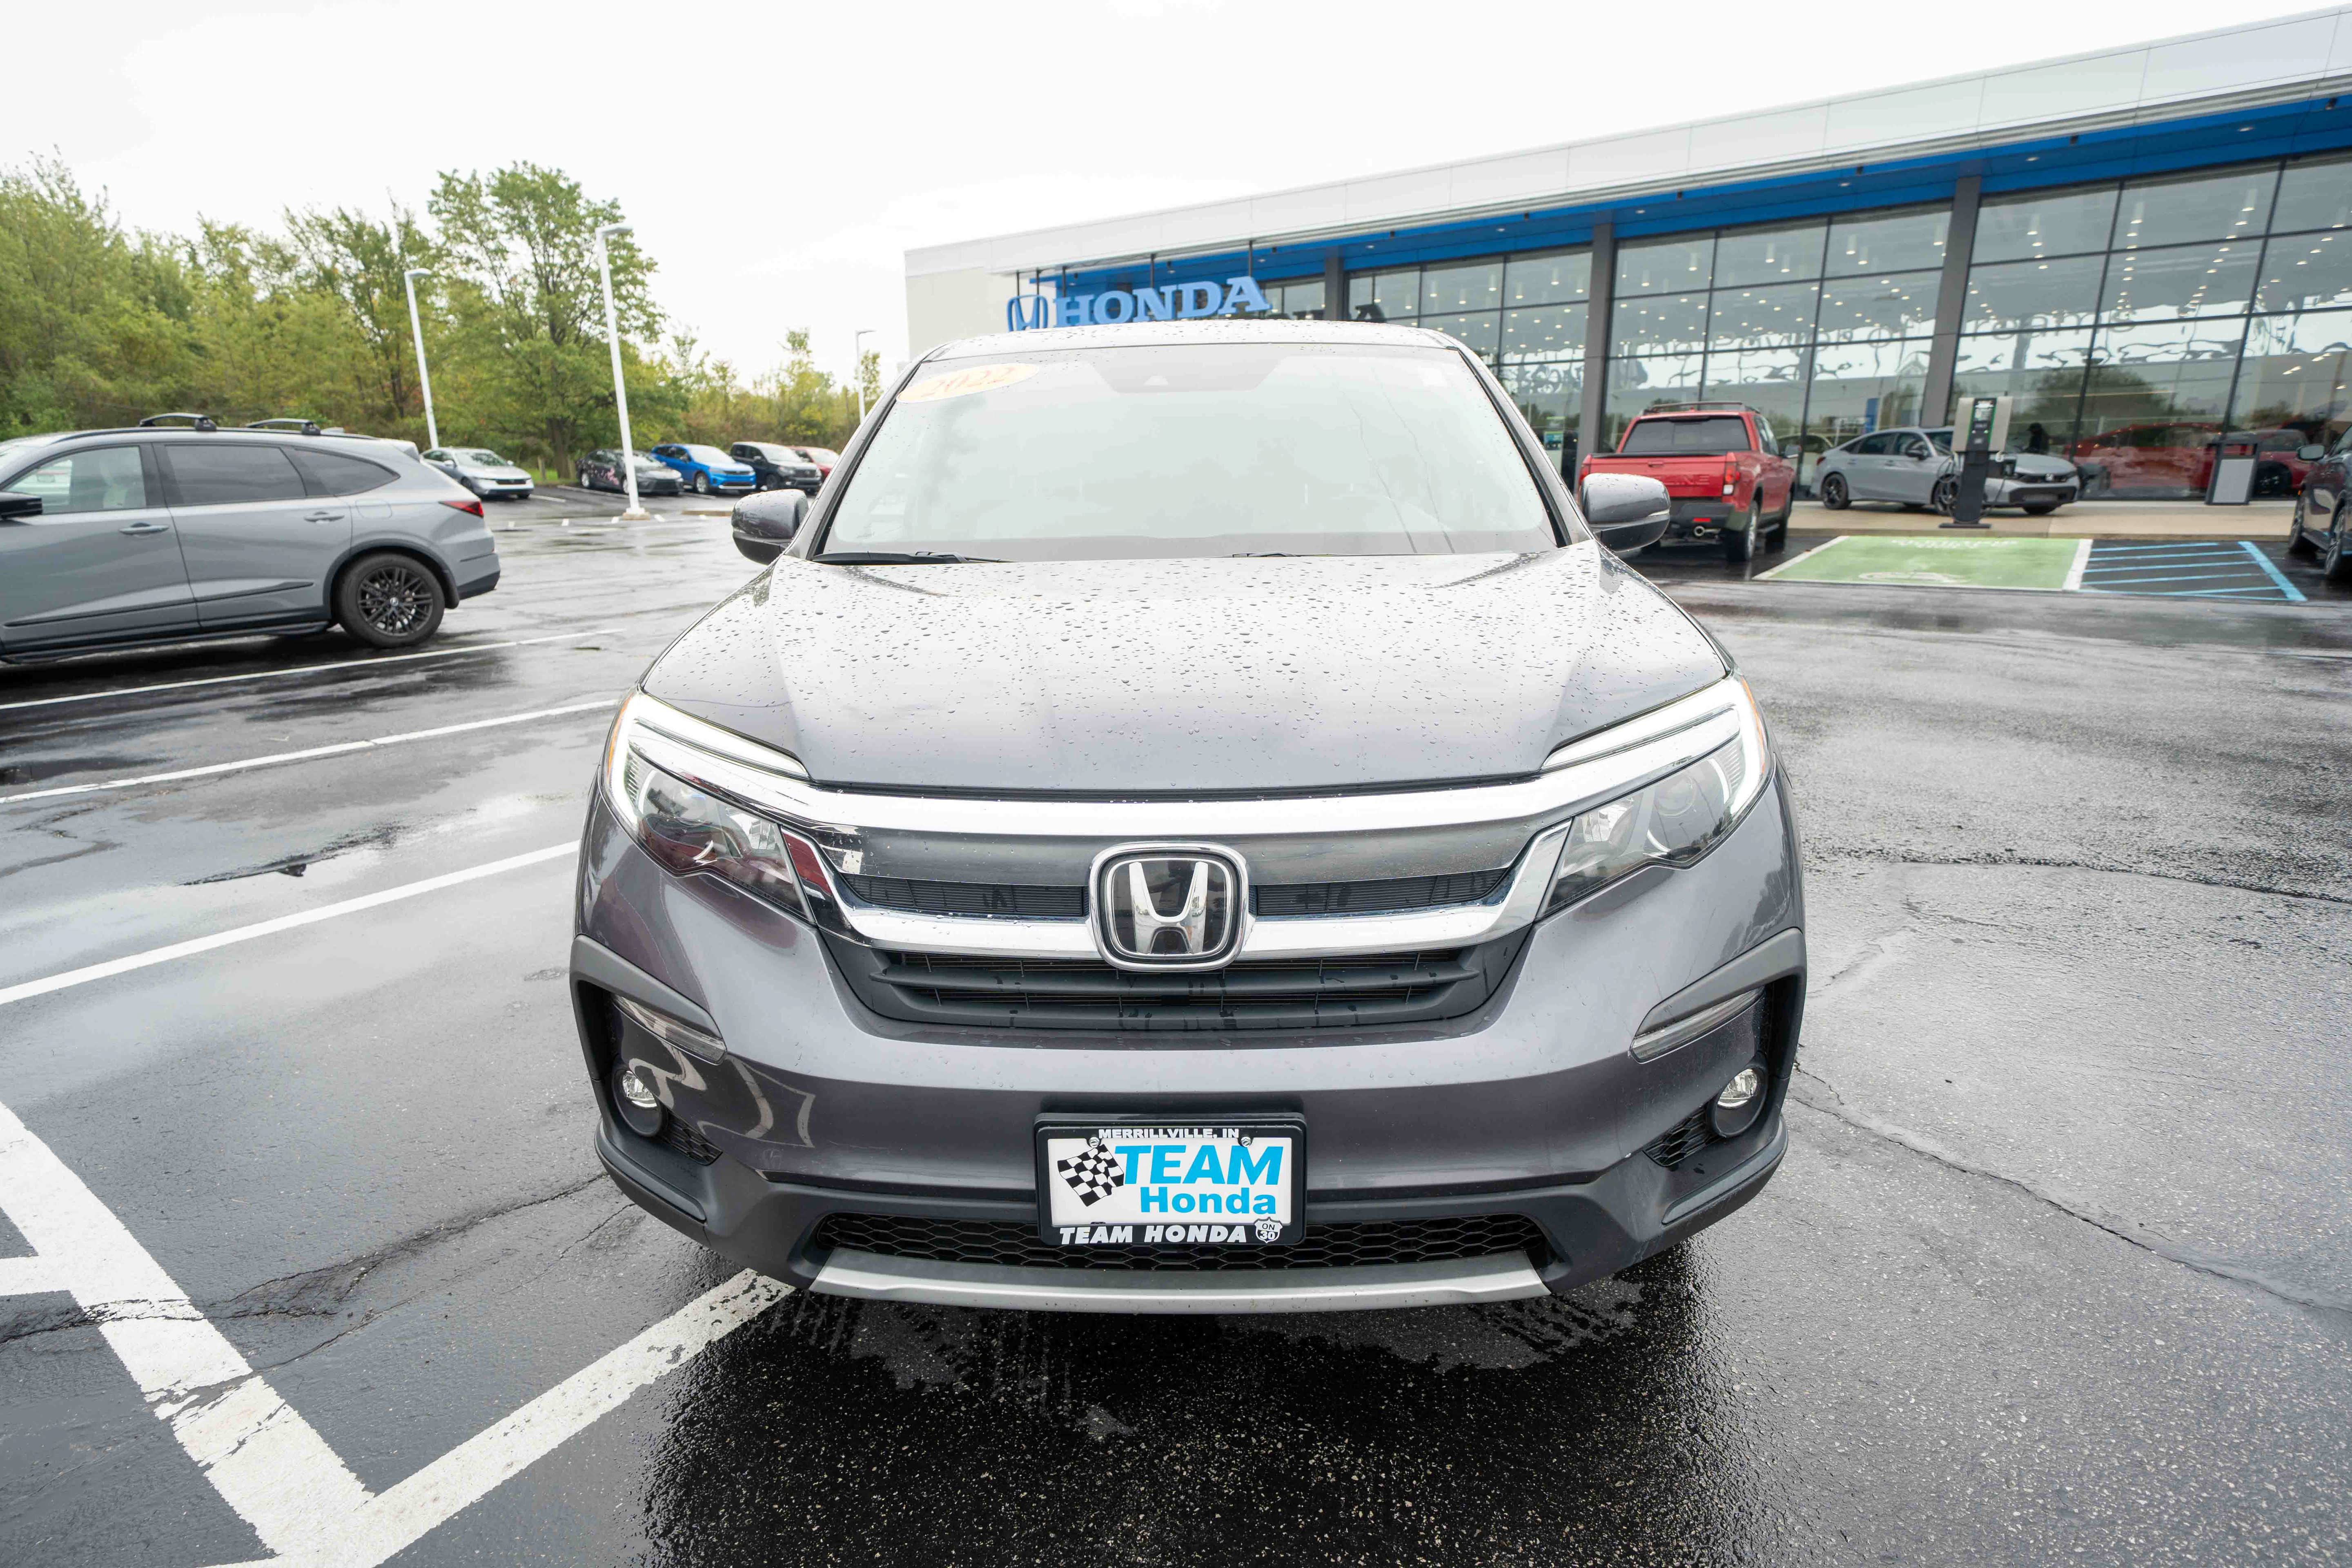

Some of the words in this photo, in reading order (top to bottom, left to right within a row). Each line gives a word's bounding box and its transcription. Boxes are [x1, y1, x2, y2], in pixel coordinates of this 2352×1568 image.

[1054, 276, 1273, 327] HONDA
[1098, 1129, 1218, 1139] MERRILLVILLE,
[1222, 1128, 1239, 1138] IN
[1114, 1145, 1284, 1185] TEAM
[1140, 1187, 1276, 1214] Honda
[1059, 1225, 1133, 1245] TEAM
[1144, 1225, 1247, 1243] HONDA
[1259, 1230, 1276, 1240] 30
